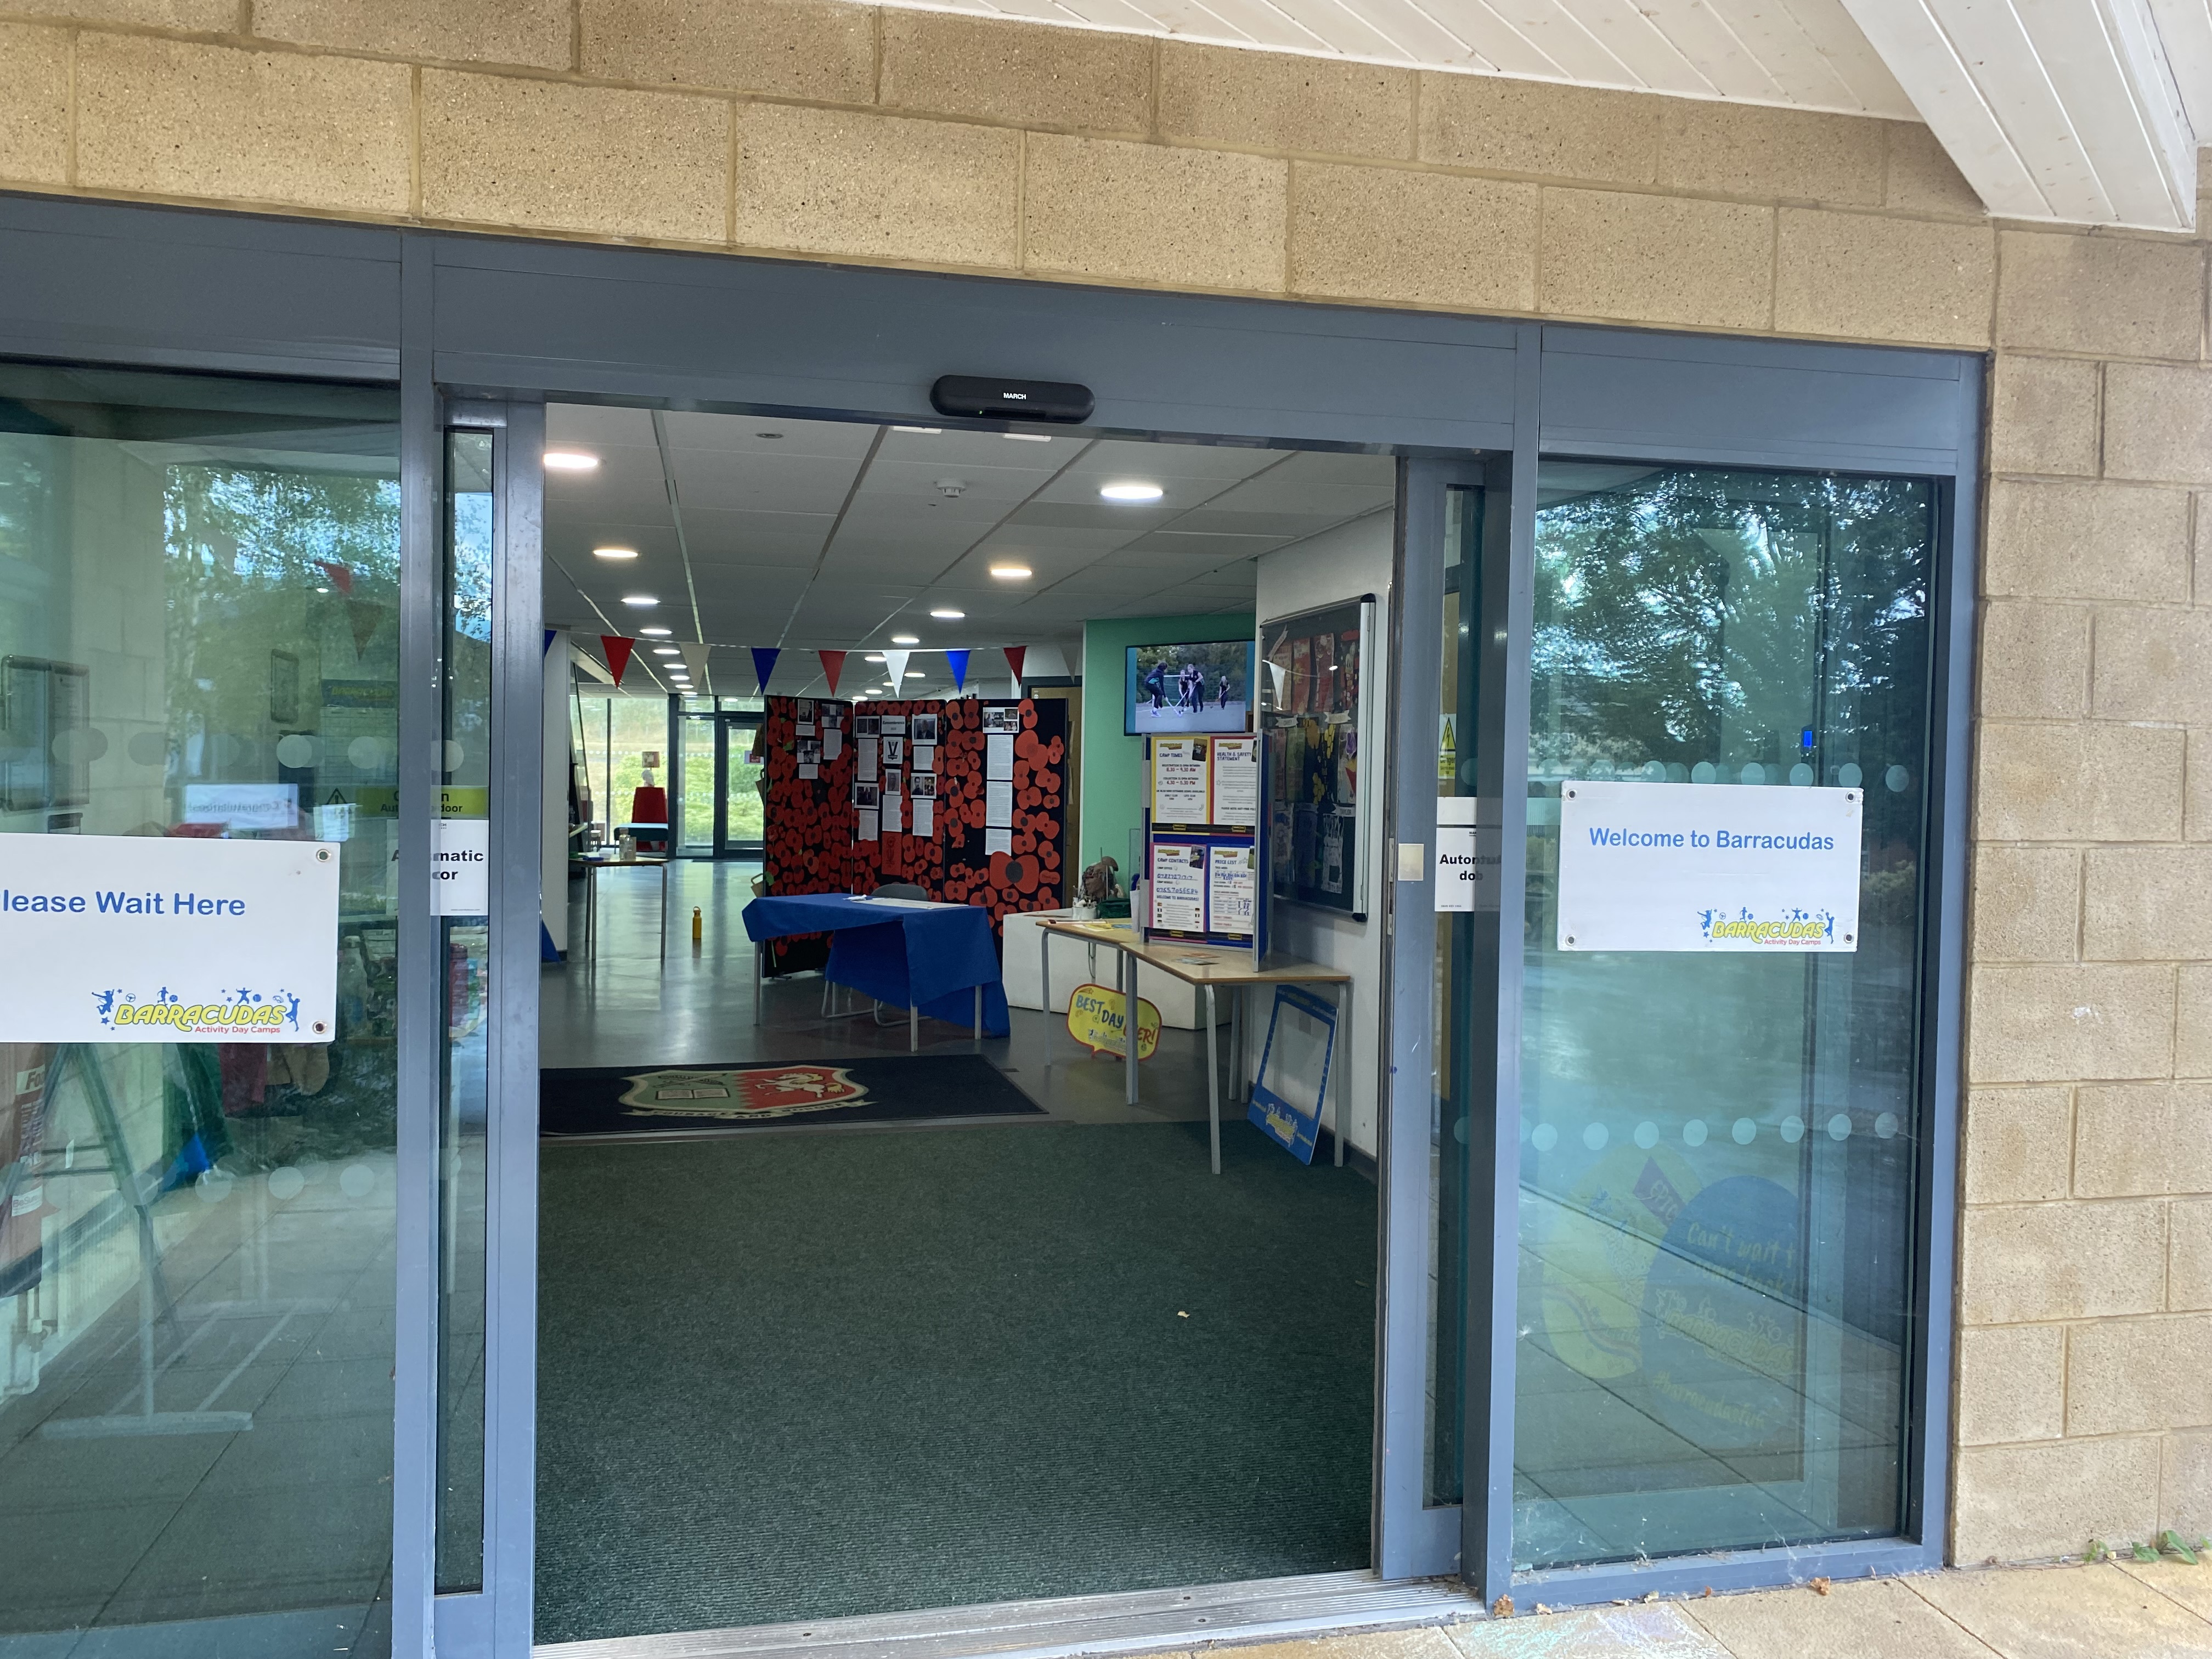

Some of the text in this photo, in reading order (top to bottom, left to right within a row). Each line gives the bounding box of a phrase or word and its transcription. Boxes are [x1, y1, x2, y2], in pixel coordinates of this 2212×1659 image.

[1589, 827, 1834, 850] Welcome to Barracudas
[0, 889, 246, 916] lease Wait Here
[1712, 921, 1826, 944] BARRACUDAS
[1075, 995, 1104, 1015] BEST
[114, 1004, 287, 1032] BARRACUDAS
[195, 1025, 281, 1034] Activity Day Camps
[1102, 1009, 1124, 1029] DAY
